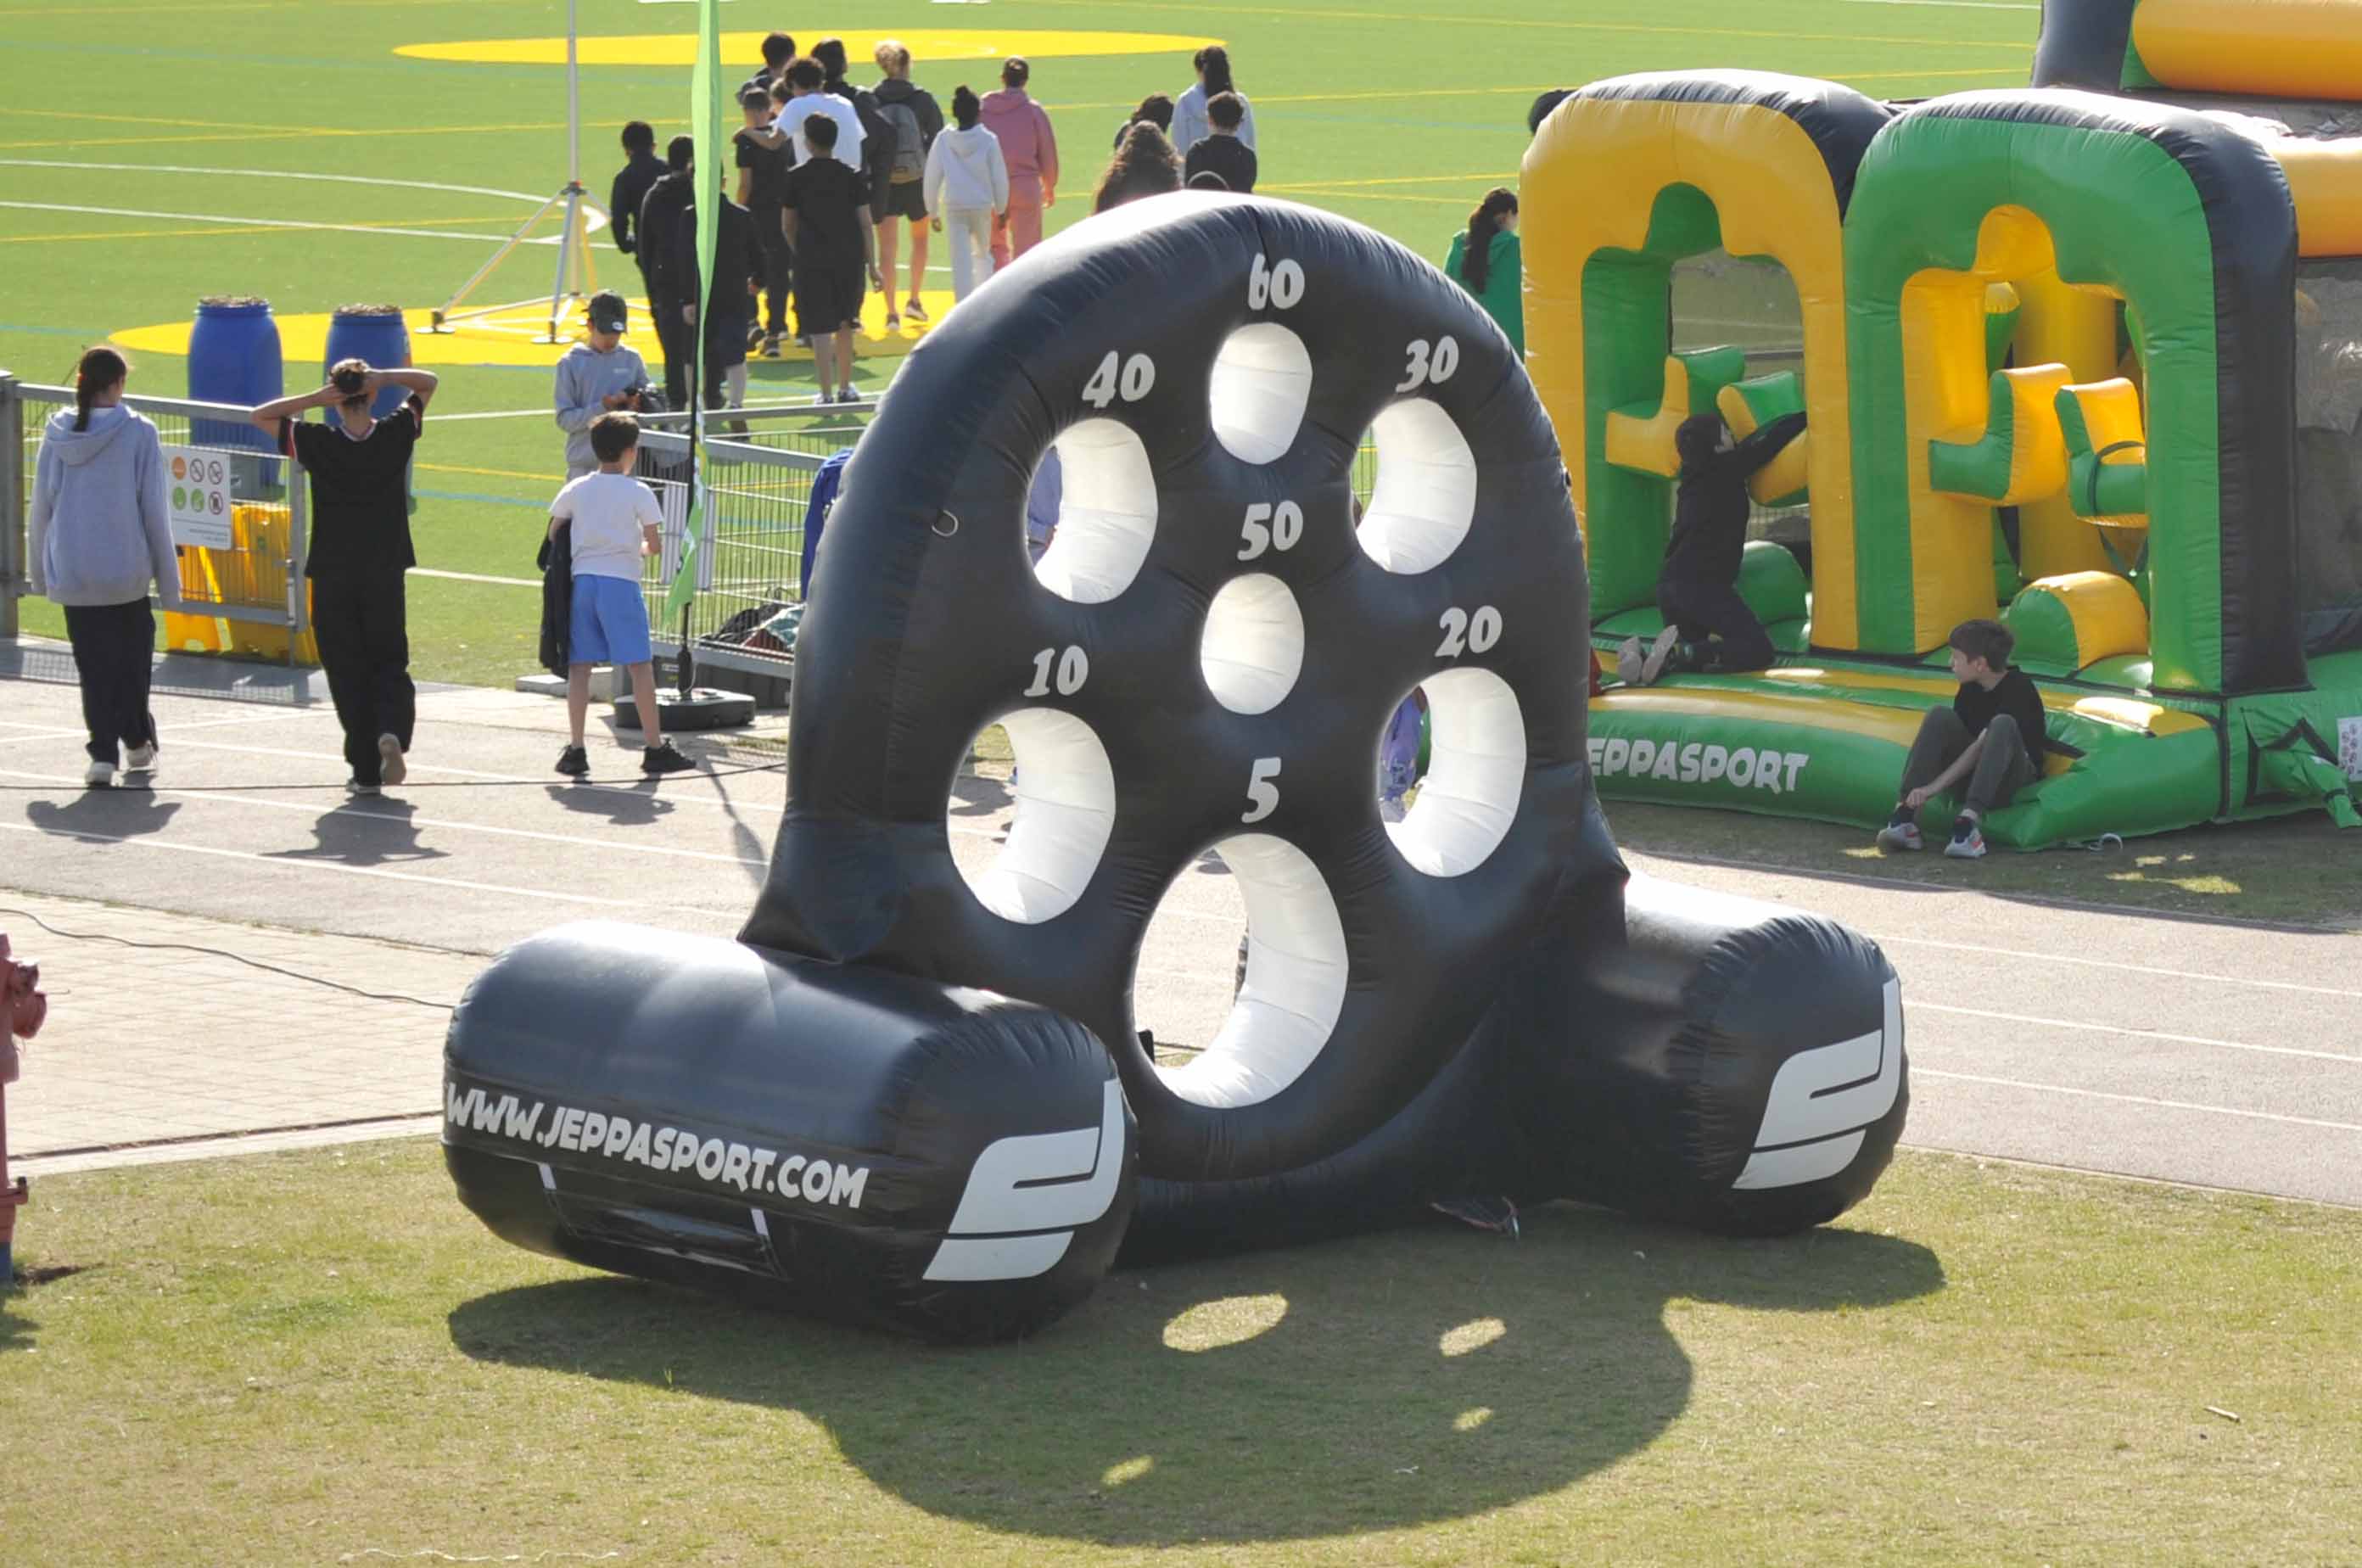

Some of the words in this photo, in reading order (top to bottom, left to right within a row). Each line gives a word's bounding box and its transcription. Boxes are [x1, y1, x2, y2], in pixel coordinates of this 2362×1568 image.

[1247, 253, 1305, 311] 60
[1082, 350, 1156, 408] 40
[1396, 335, 1459, 393] 30
[1237, 500, 1304, 561] 50
[1435, 605, 1503, 658] 20
[1023, 645, 1089, 697] 10
[1241, 757, 1283, 824] 5
[1587, 737, 1809, 794] EPPASPORT
[446, 1082, 870, 1210] WWW.JEPPASPORT.COM
